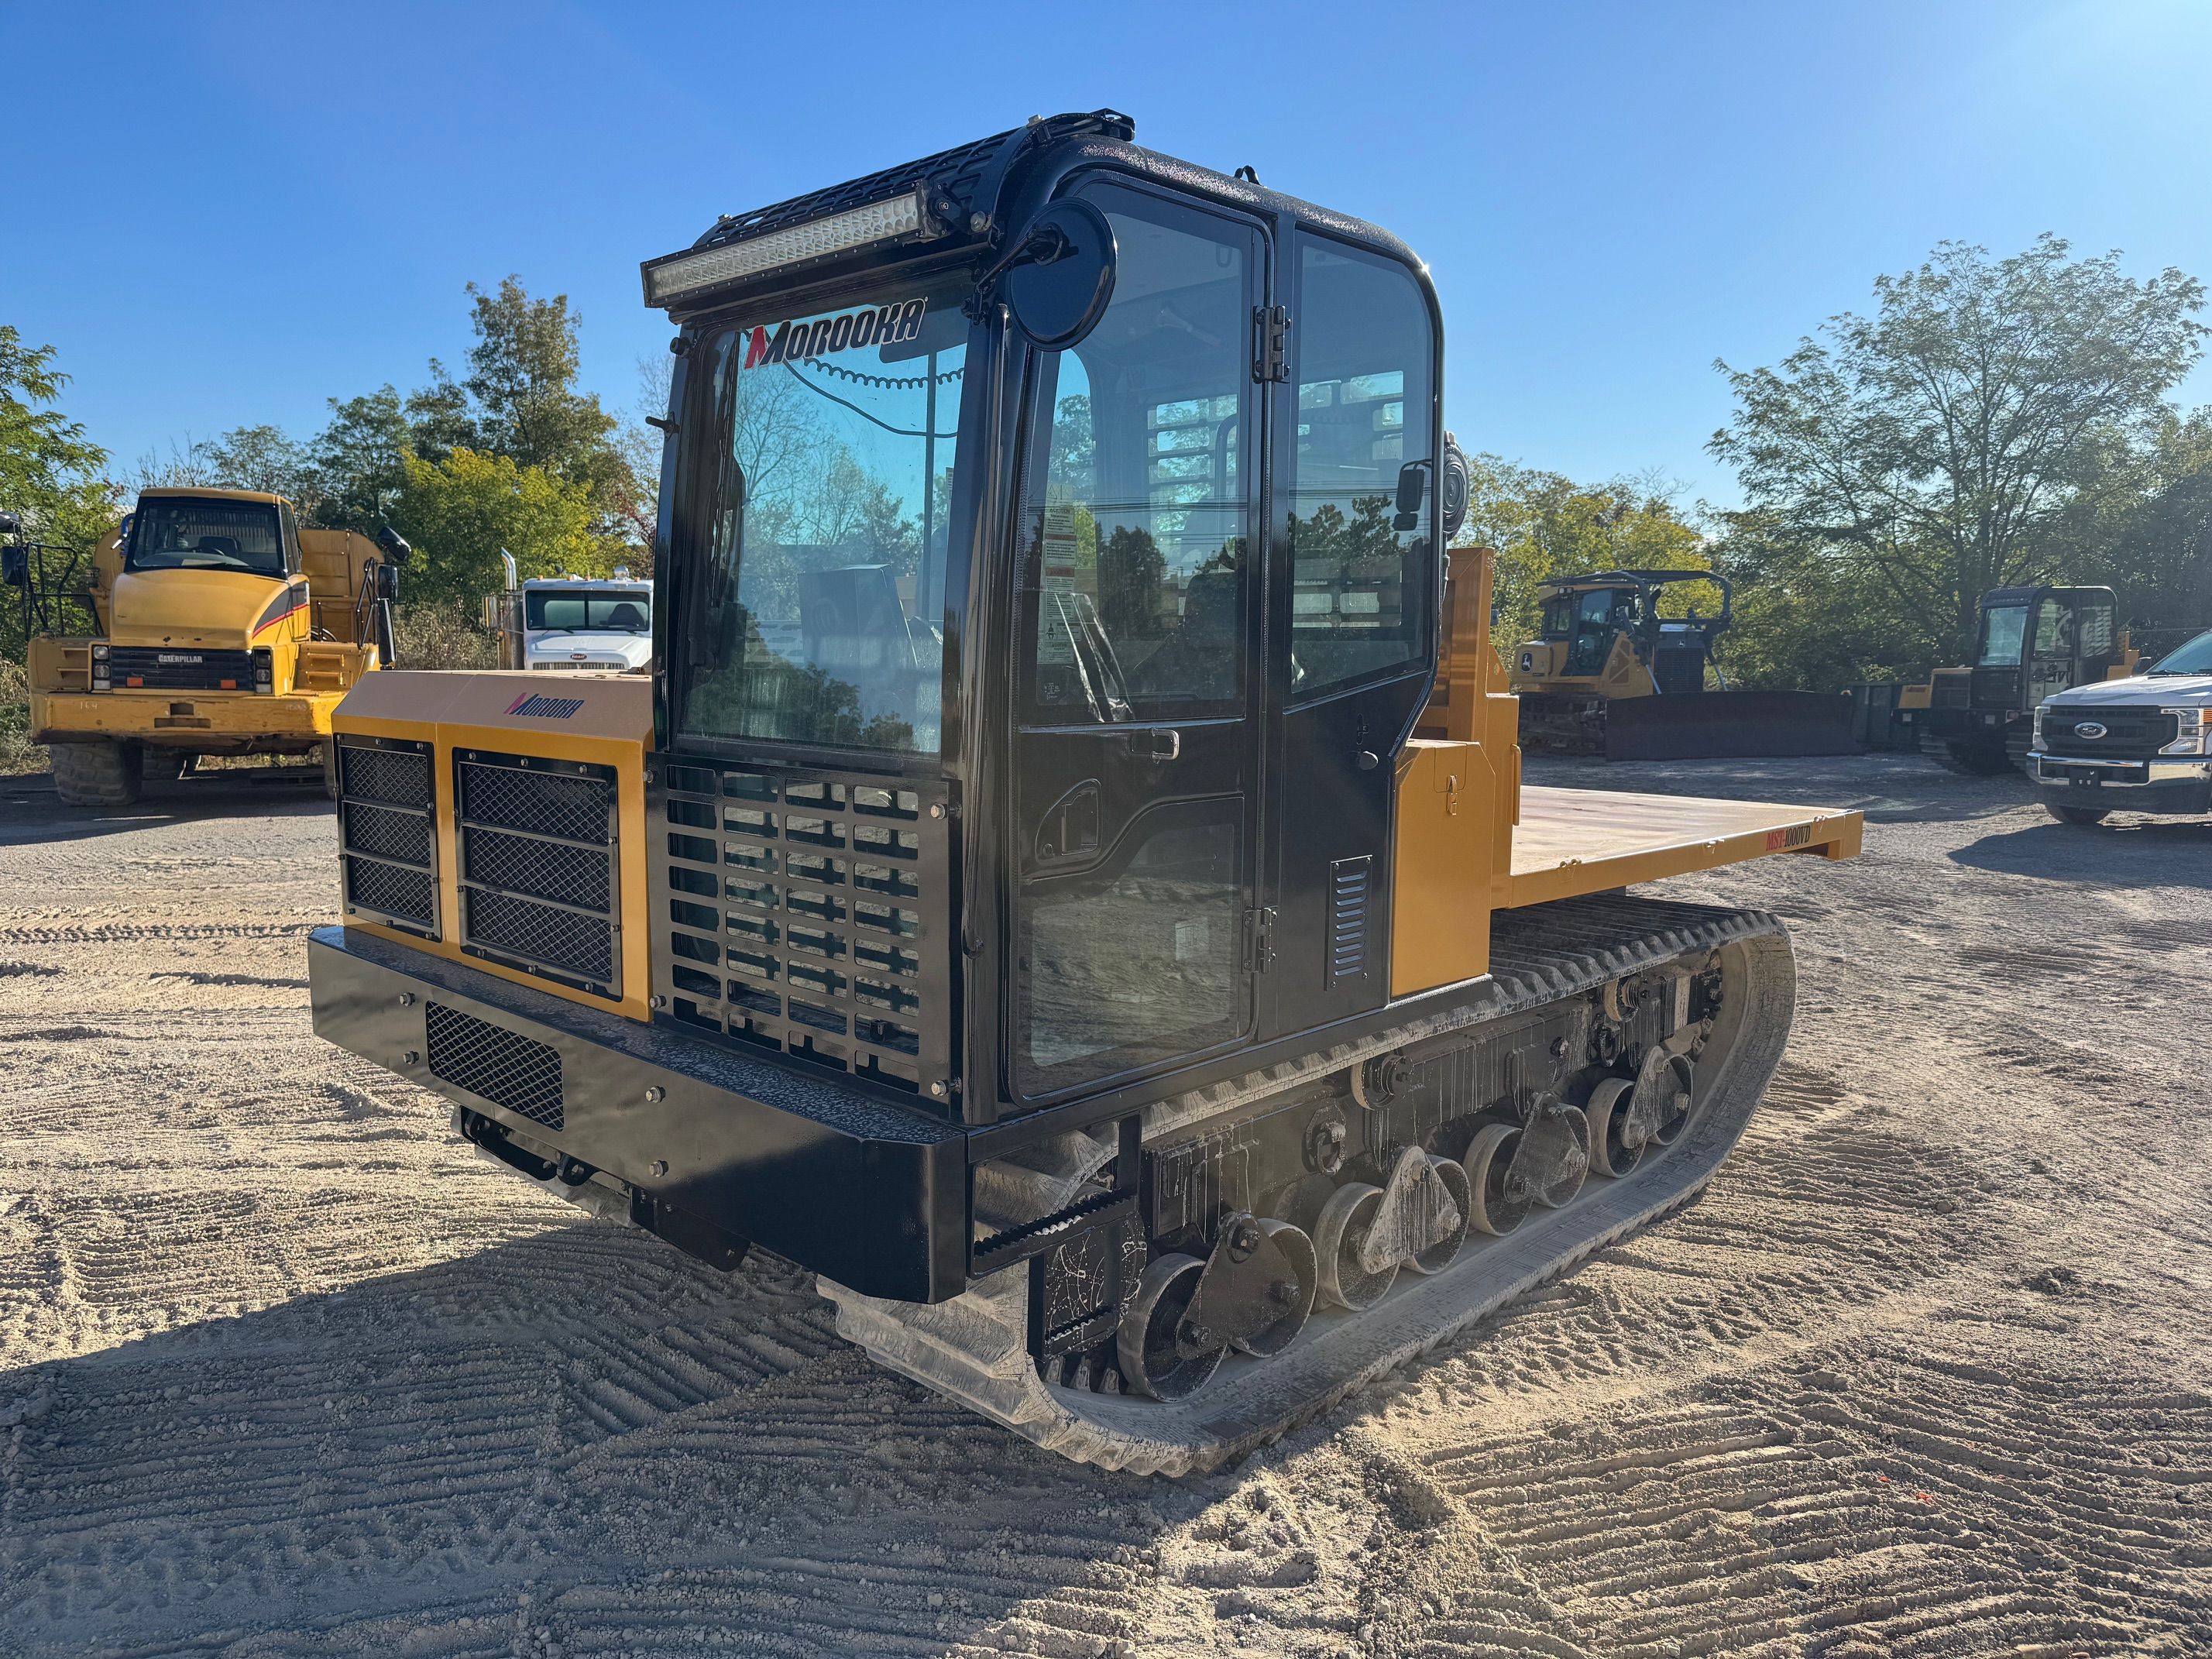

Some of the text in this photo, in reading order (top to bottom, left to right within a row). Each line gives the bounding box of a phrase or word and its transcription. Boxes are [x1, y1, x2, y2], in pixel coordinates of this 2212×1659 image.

[744, 297, 926, 369] MOROOKA
[158, 654, 203, 664] CATERPILLAR
[503, 692, 585, 719] MOROOKA
[1766, 825, 1811, 851] MST-1000VD
